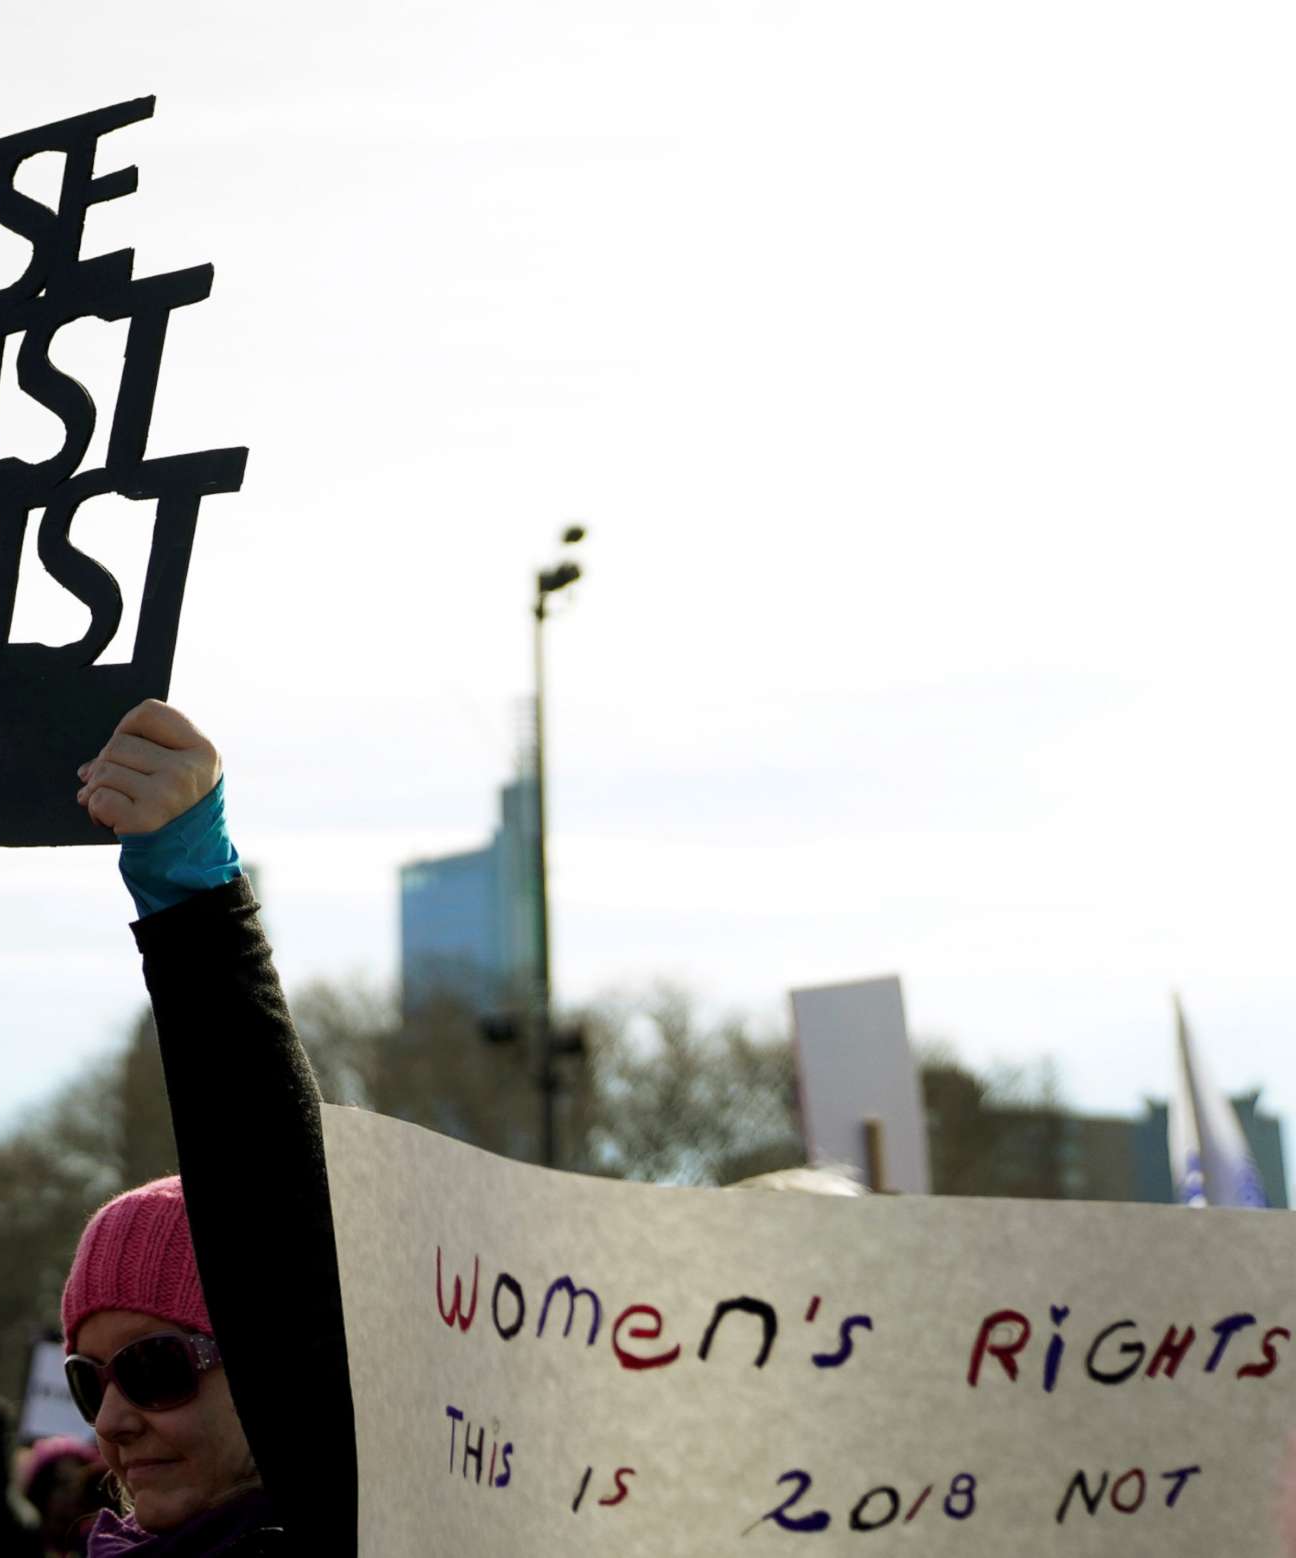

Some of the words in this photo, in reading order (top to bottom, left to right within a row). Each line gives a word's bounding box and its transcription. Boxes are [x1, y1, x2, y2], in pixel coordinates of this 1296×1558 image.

[436, 1246, 873, 1370] Women's
[571, 1466, 637, 1514] IS
[754, 1470, 977, 1533] 2018
[1055, 1465, 1202, 1524] NOT
